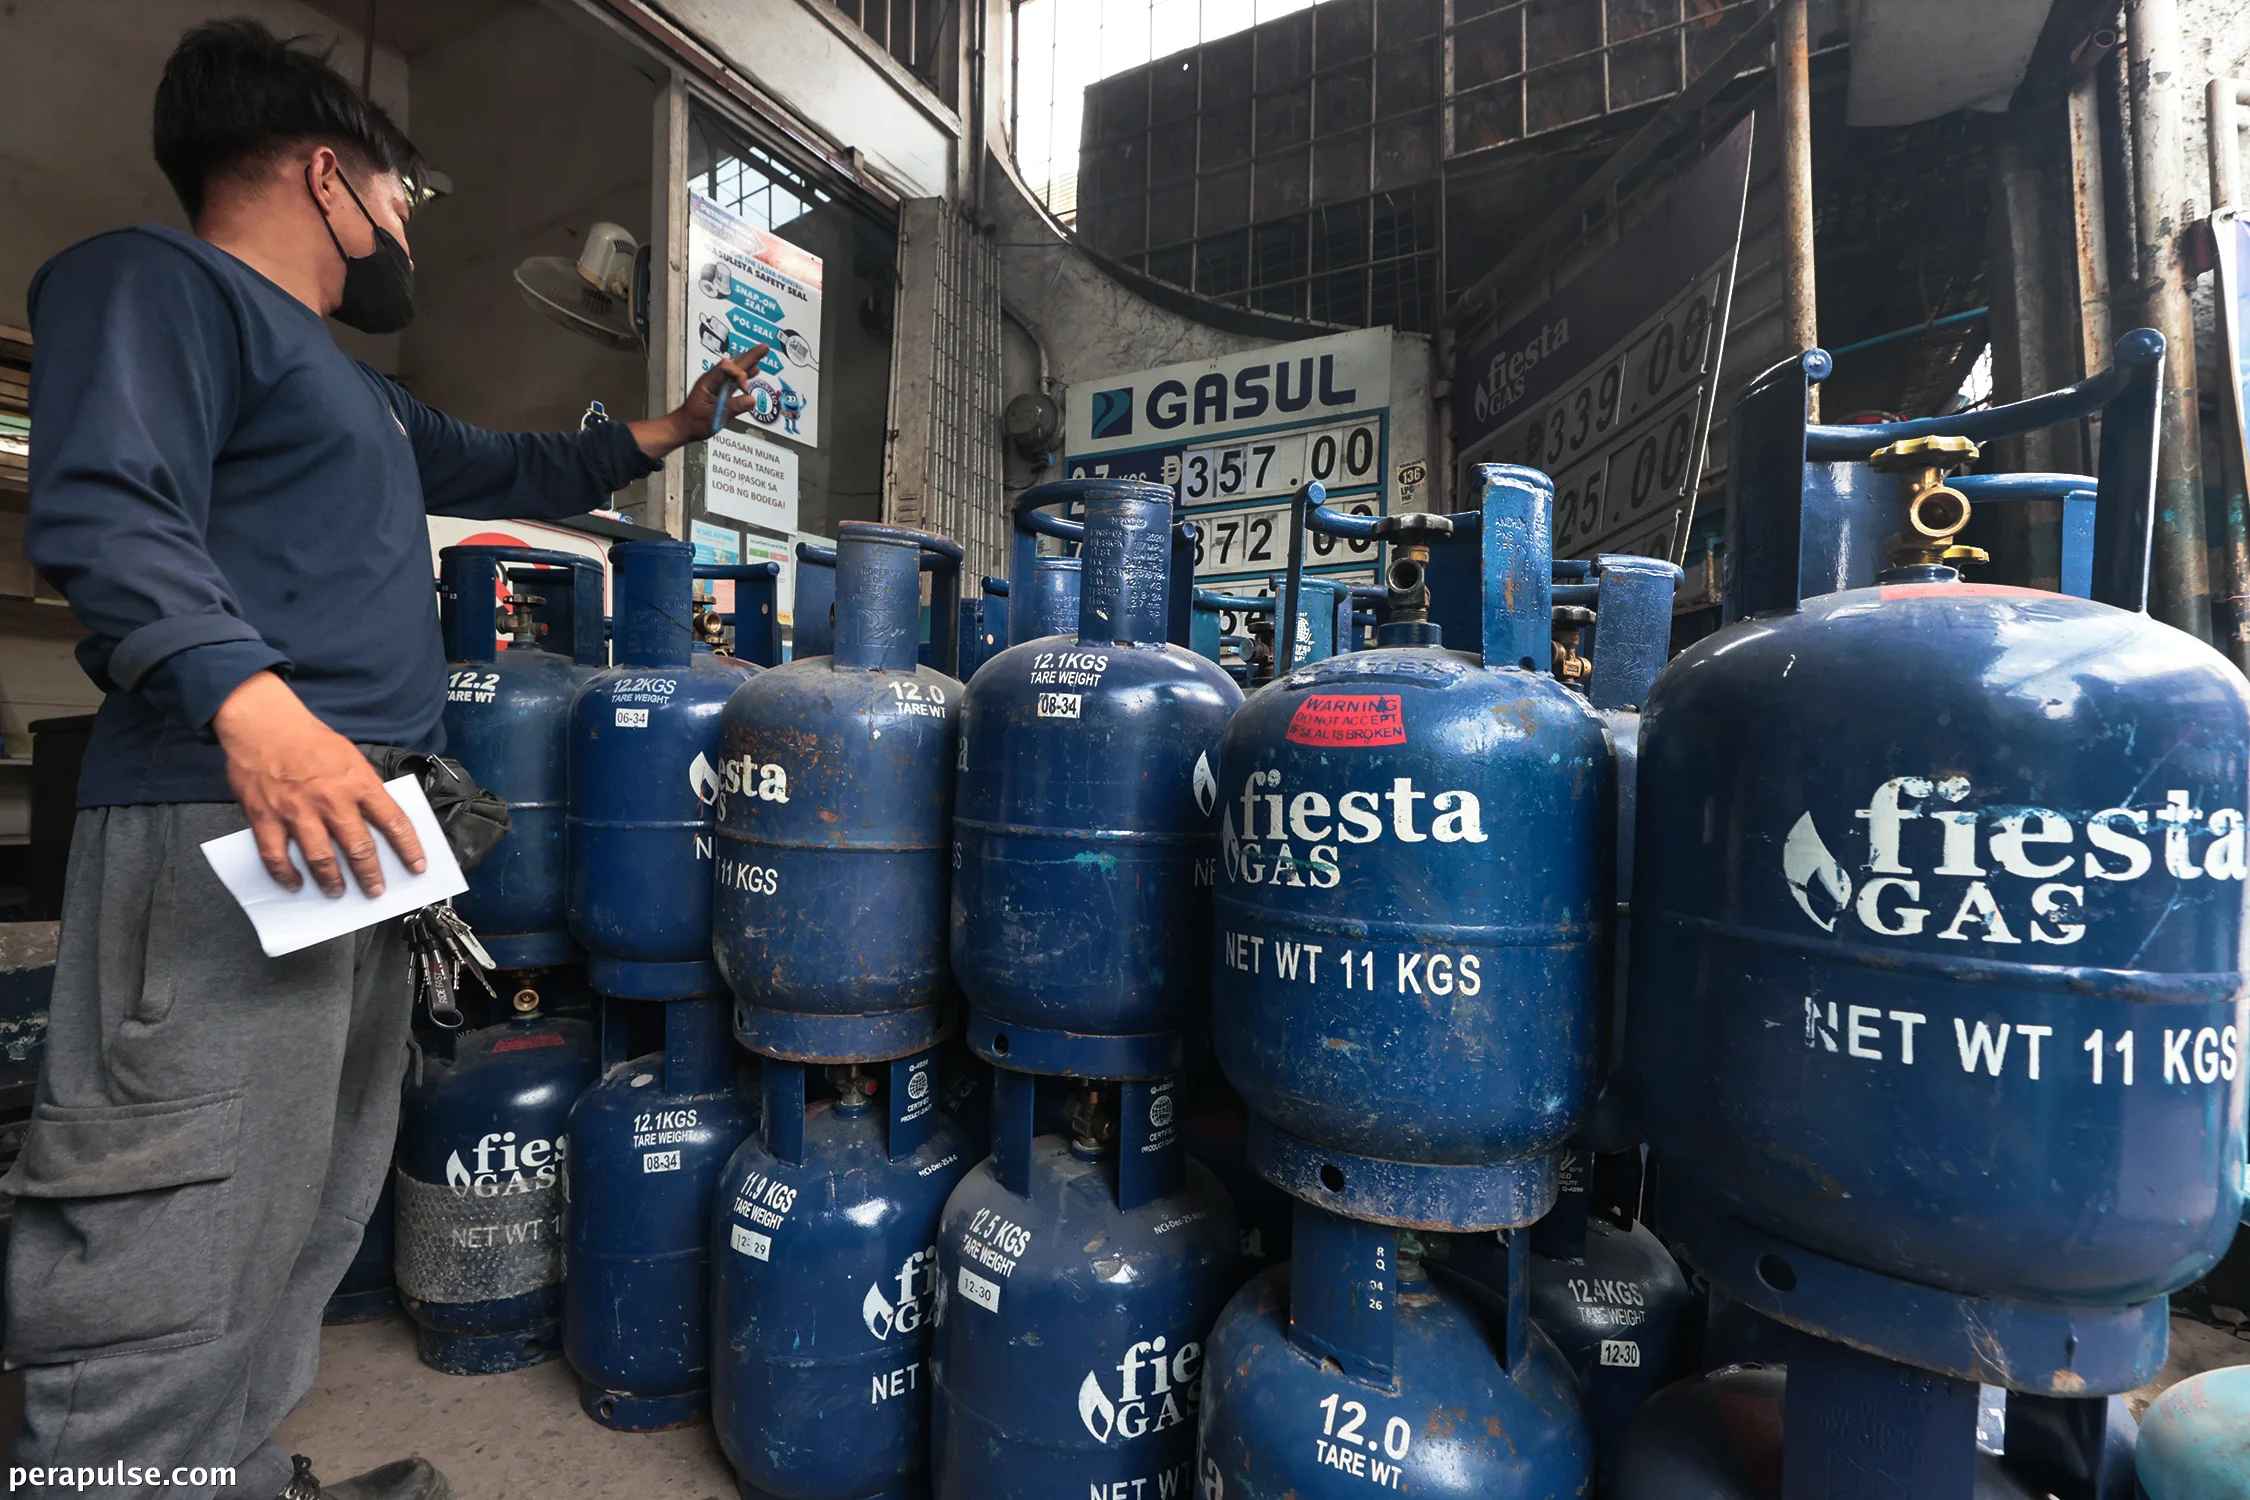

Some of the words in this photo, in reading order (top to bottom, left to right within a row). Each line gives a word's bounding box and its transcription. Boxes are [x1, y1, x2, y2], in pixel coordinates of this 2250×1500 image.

[735, 284, 776, 311] SNAP-ON
[754, 269, 786, 291] SAFETY
[787, 286, 808, 302] SEAL
[745, 299, 766, 315] SEAL
[733, 314, 751, 329] POL
[753, 324, 774, 341] SEAL
[1487, 317, 1570, 397] fiesta
[1146, 354, 1356, 429] GASUL
[1547, 294, 1708, 466] 339.00
[1489, 378, 1526, 417] GAS
[712, 435, 754, 455] HUGASAN
[755, 449, 781, 464] MUNA
[1186, 427, 1374, 499] 357.00
[712, 449, 731, 462] ANG
[733, 456, 753, 470] MGA
[754, 463, 785, 480] TANGKE
[712, 464, 736, 479] BAGO
[738, 472, 767, 489] IPASOK
[768, 482, 778, 492] SA
[1402, 467, 1421, 484] 136
[1553, 410, 1690, 550] 25.00
[712, 480, 735, 494] LOOB
[736, 487, 749, 498] NG
[751, 491, 786, 509] BODEGA!
[1033, 653, 1109, 672] 12.1KGS
[449, 671, 500, 692] 12.2
[614, 678, 677, 694] 12.2KGS
[889, 680, 946, 704] 12.0
[1030, 671, 1057, 684] TARE
[1058, 671, 1102, 687] WEIGHT
[448, 690, 472, 701] ARE
[475, 691, 496, 703] WT
[611, 693, 632, 703] TARE
[634, 693, 670, 704] WEIGHT
[895, 701, 928, 716] TARE
[928, 704, 946, 719] WT
[1041, 695, 1077, 714] 08-34
[1306, 697, 1398, 713] WARNING
[617, 712, 646, 723] 06-34
[1295, 713, 1313, 725] DO
[1313, 714, 1339, 726] NOT
[1343, 714, 1397, 726] ACCEPT
[1299, 727, 1329, 740] SEAL
[1332, 730, 1345, 740] IS
[1346, 726, 1403, 741] BROKEN
[1240, 768, 1488, 844] fiesta
[1854, 776, 2249, 881] fiesta
[736, 862, 778, 896] KGS
[1240, 843, 1341, 888] GAS
[1857, 877, 2087, 946] GAS
[1225, 930, 1264, 974] NET
[1275, 941, 1322, 984] WT
[1340, 949, 1374, 991] 11
[1398, 952, 1481, 996] KGS
[1804, 998, 1926, 1066] NET
[1954, 1017, 2052, 1081] WT
[2083, 1029, 2134, 1086] 11
[2164, 1025, 2237, 1085] KGS
[633, 1109, 698, 1133] 12.1KGS
[633, 1133, 657, 1149] TARE
[658, 1129, 695, 1146] WEIGHT
[646, 1153, 678, 1171] 08-34
[473, 1163, 557, 1199] GAS
[740, 1171, 766, 1201] 11.9
[764, 1179, 798, 1214] KGS
[733, 1196, 751, 1215] TARE
[750, 1202, 784, 1231] WEIGHT
[451, 1226, 499, 1249] NET
[504, 1219, 543, 1246] WT
[969, 1207, 1001, 1239] 12.5
[993, 1220, 1032, 1258] KGS
[963, 1234, 983, 1260] TARE
[979, 1244, 1017, 1278] WEIGHT
[964, 1278, 992, 1302] 12-30
[1369, 1298, 1383, 1311] 26
[1608, 1307, 1646, 1326] WEIGHT
[1604, 1344, 1638, 1364] 12-30
[871, 1362, 920, 1405] NET
[1320, 1393, 1411, 1460] 12.0
[1316, 1439, 1367, 1478] TARE
[1371, 1458, 1403, 1490] WT
[1090, 1477, 1148, 1500] NET
